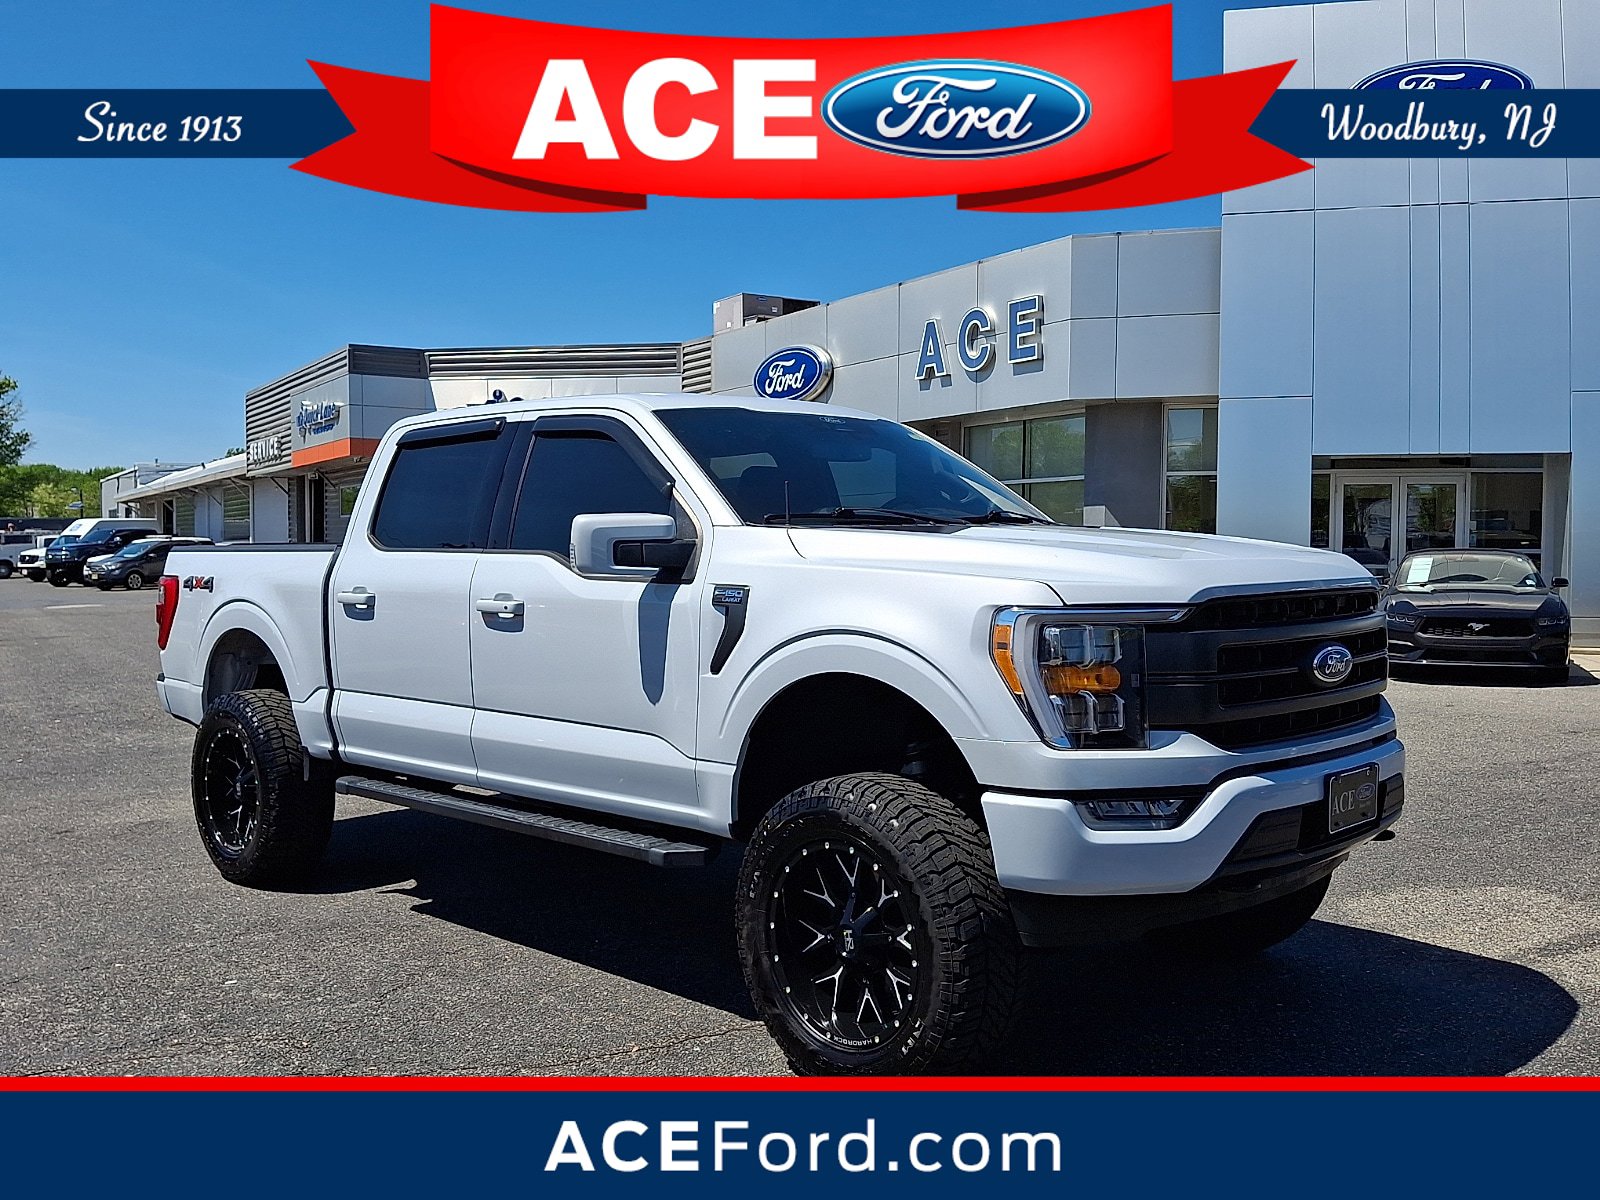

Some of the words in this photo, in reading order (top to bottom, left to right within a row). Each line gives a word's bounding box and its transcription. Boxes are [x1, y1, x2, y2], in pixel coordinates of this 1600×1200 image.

[914, 294, 1044, 381] ACE
[765, 359, 806, 394] Ford
[249, 437, 279, 460] SERVICE
[1325, 654, 1347, 674] Ford
[1332, 790, 1356, 816] ACE
